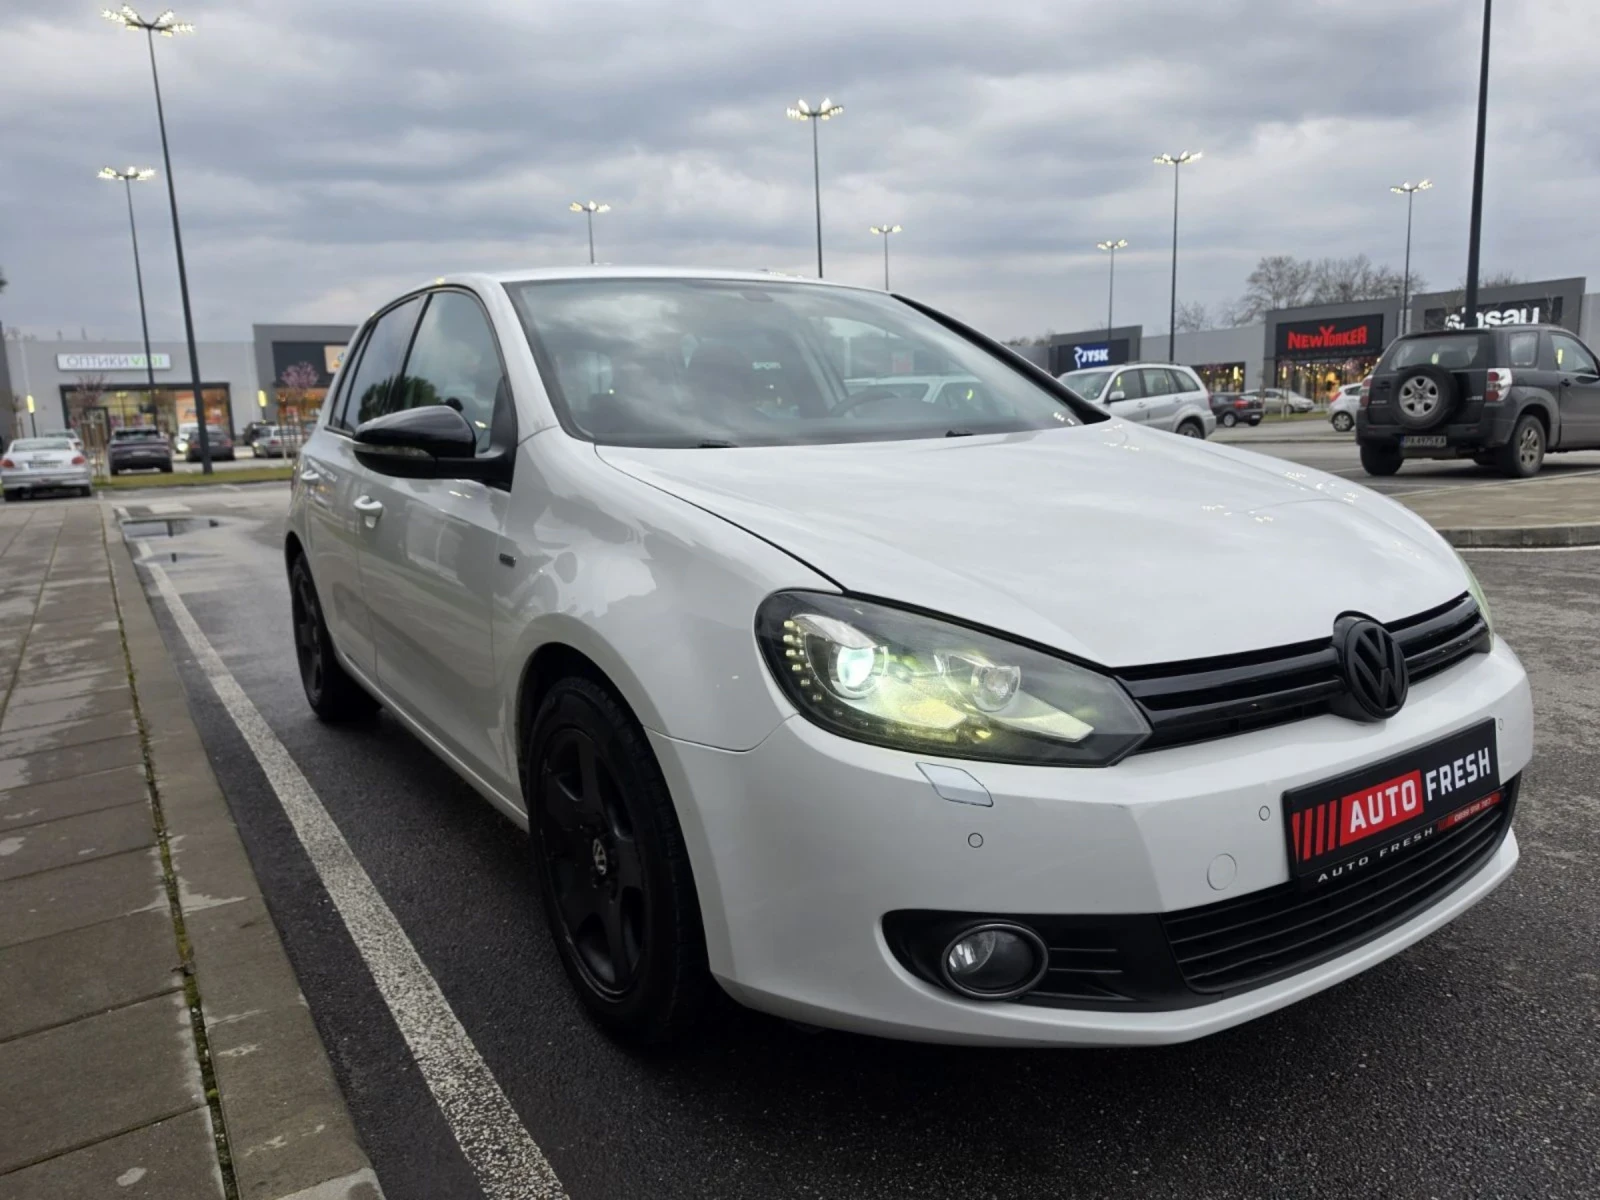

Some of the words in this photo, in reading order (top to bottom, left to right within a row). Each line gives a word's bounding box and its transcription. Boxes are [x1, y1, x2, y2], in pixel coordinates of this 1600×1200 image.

[67, 355, 128, 366] ОПТИКИ
[1081, 347, 1109, 362] JYSK
[1350, 779, 1417, 833] AUTO
[1425, 747, 1491, 802] FRESH
[1317, 857, 1369, 883] AUTO
[1379, 828, 1433, 858] FRESH
